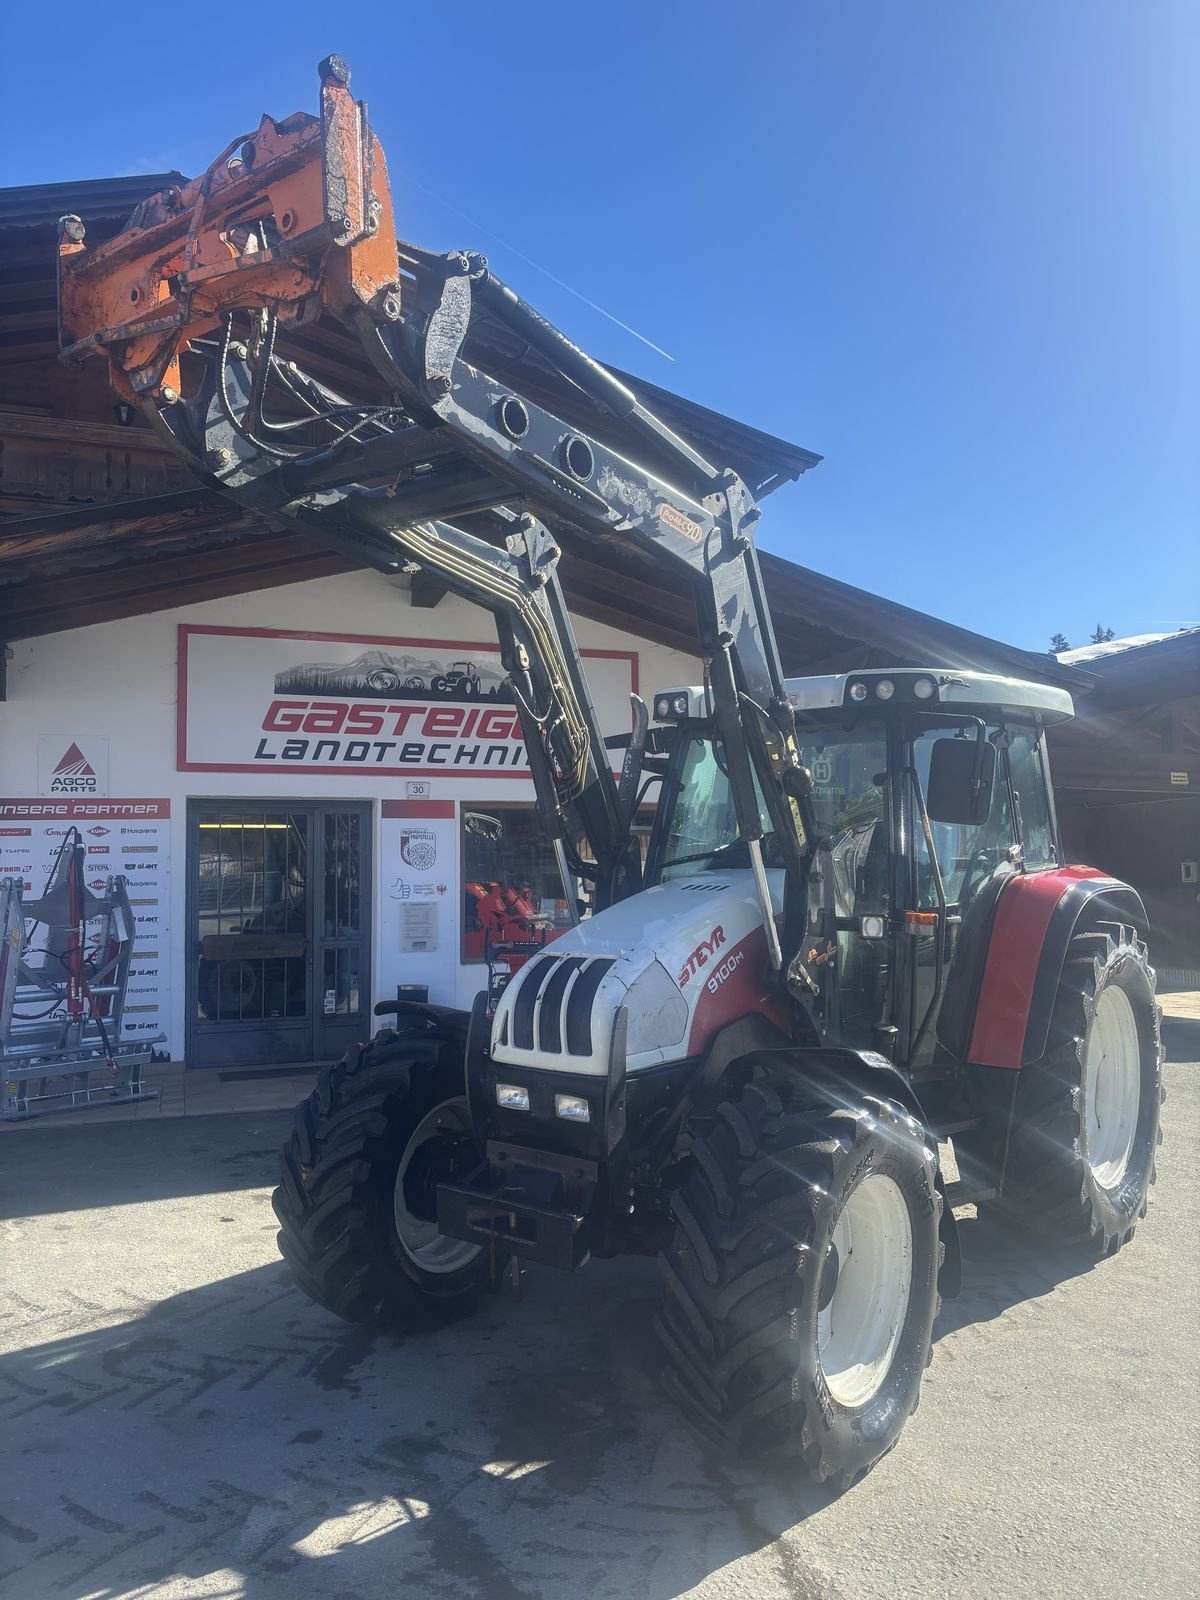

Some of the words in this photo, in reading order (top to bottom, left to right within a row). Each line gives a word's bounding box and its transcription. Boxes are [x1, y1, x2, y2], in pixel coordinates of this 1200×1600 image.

[262, 700, 525, 741] GASTEIG
[254, 738, 529, 766] LANDTECHNI
[52, 777, 97, 786] AGCO
[413, 786, 424, 794] 30
[811, 784, 845, 795] sqvarna
[0, 805, 68, 815] NSERE
[73, 805, 159, 814] PARTNER
[127, 827, 158, 835] Husqvarna
[134, 933, 158, 941] sqvarna
[677, 925, 727, 989] STEYR
[707, 951, 745, 995] 9100M
[127, 986, 158, 994] Husqvarna
